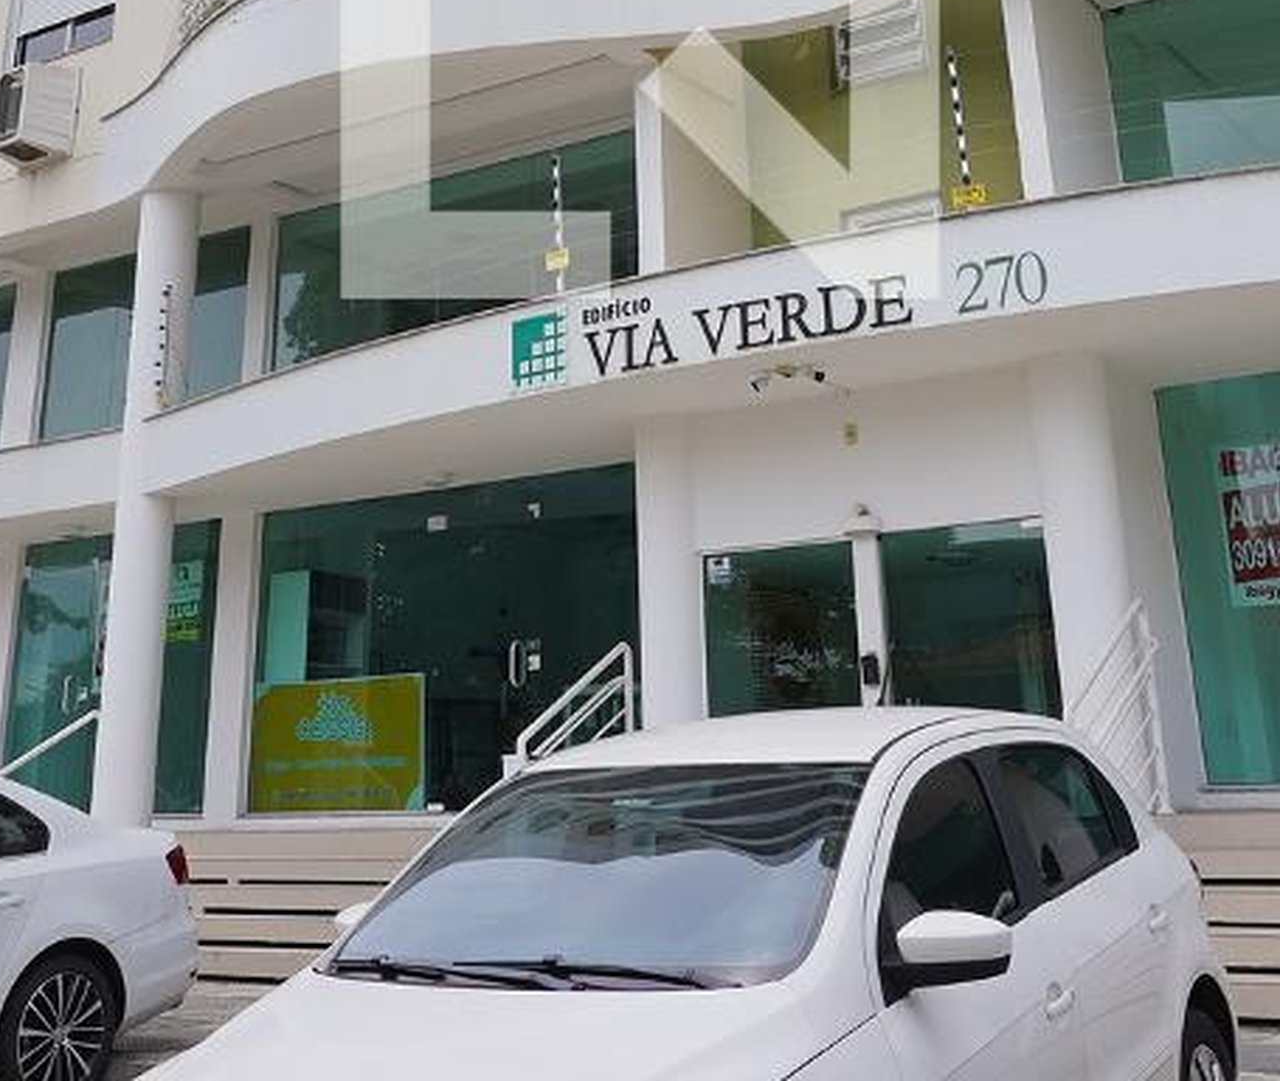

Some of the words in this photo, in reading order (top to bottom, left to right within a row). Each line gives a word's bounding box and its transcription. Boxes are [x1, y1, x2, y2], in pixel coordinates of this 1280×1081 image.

[582, 297, 651, 325] EDIFÍCIO
[584, 318, 679, 376] VIA
[692, 275, 913, 356] VERDE
[955, 250, 1048, 314] 270
